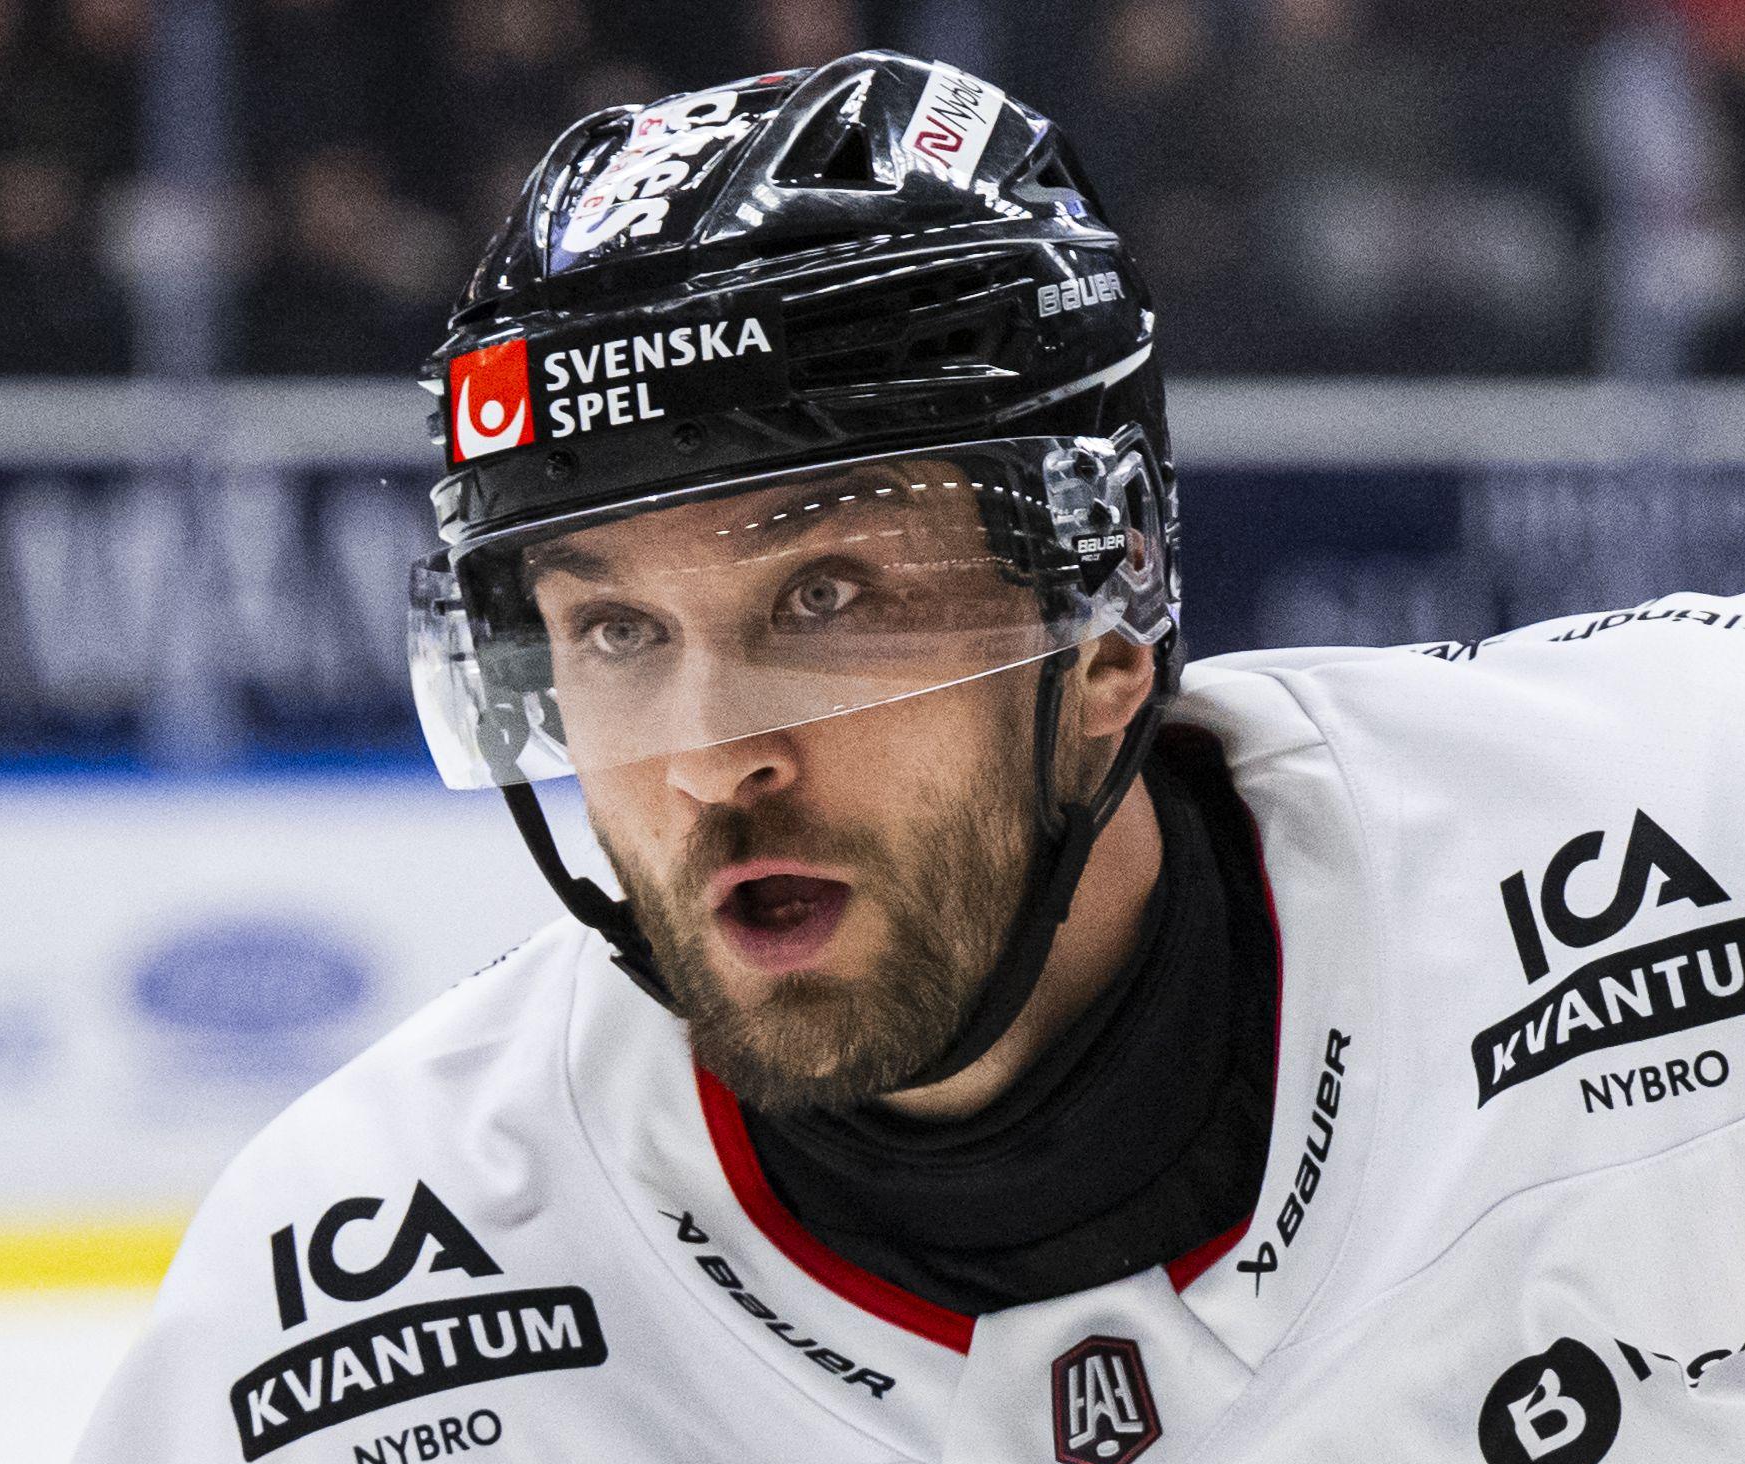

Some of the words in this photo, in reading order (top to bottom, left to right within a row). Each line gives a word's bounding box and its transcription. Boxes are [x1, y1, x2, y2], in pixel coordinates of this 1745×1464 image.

[1037, 271, 1125, 318] BAUER
[543, 317, 772, 392] SVENSKA
[549, 382, 665, 438] SPEL
[1077, 534, 1125, 553] BAUER
[1500, 808, 1732, 985] ICA
[1579, 1049, 1730, 1114] NYBRO
[1276, 1028, 1351, 1248] BAUER
[270, 1179, 504, 1331] ICA
[247, 1305, 584, 1438] KVANTUM
[694, 1255, 896, 1400] BAUER
